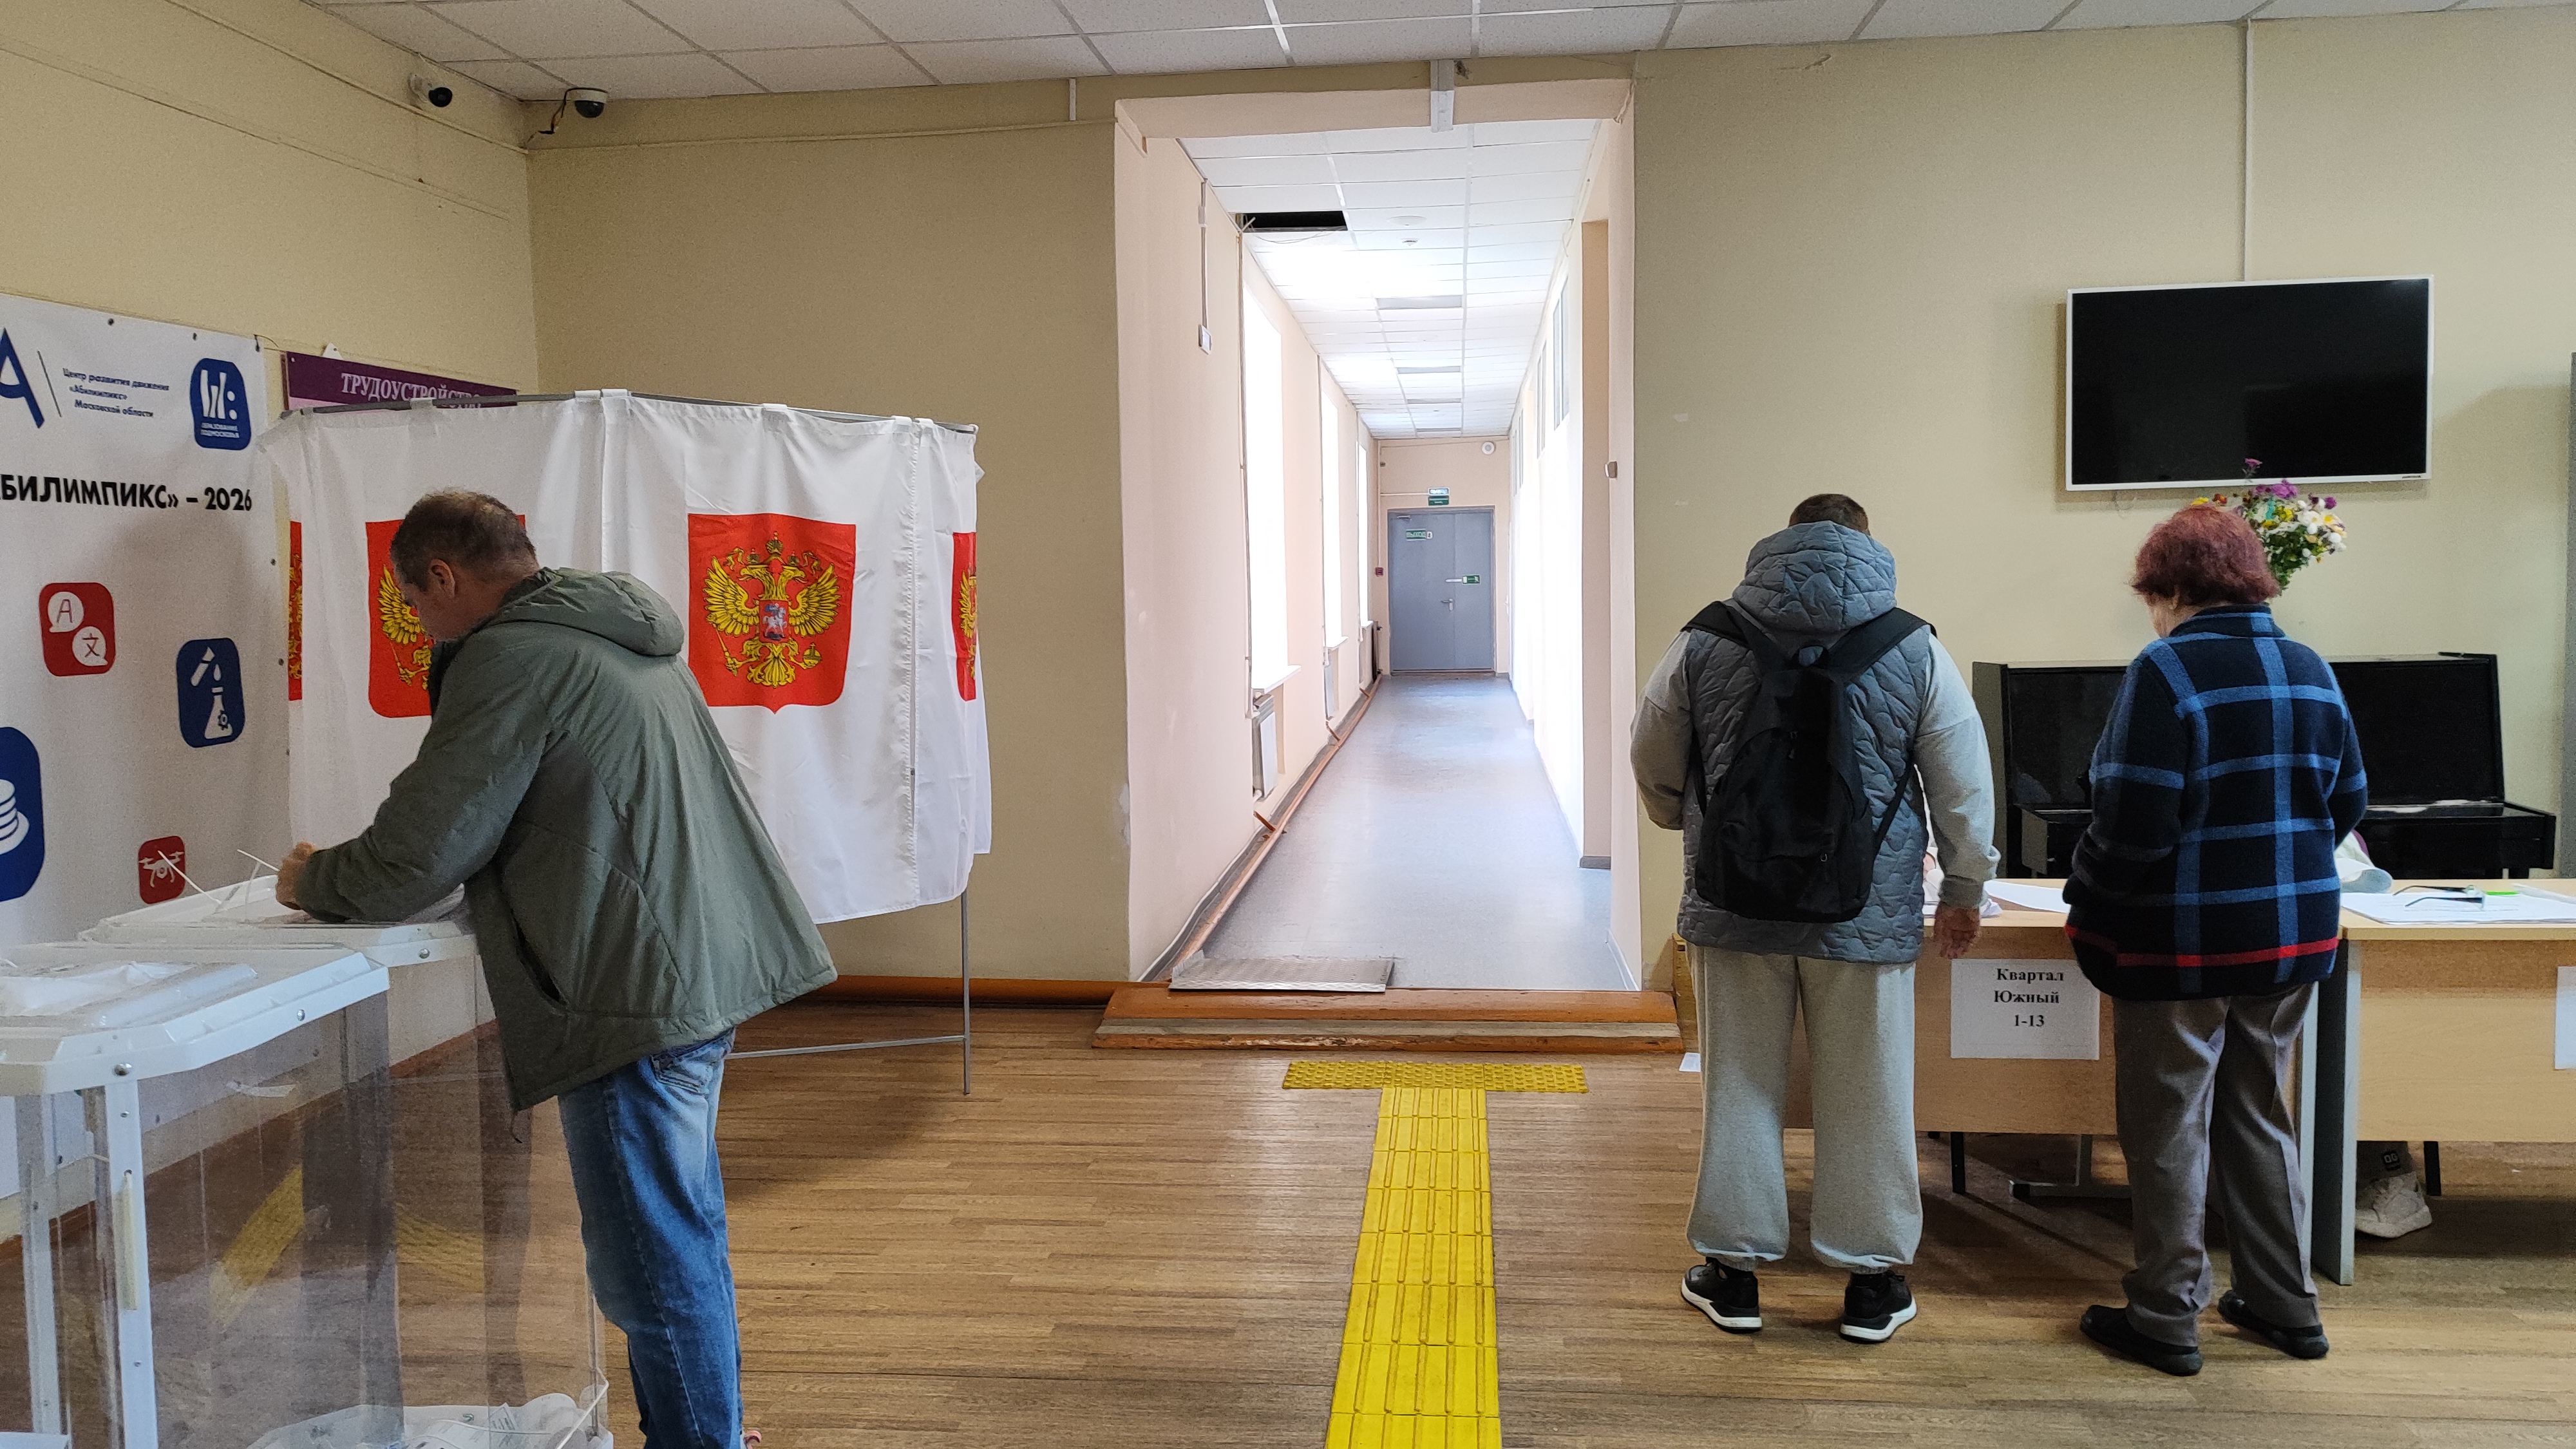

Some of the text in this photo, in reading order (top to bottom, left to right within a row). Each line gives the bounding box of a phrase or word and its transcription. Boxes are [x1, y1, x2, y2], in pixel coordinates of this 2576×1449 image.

[341, 372, 480, 402] ТРУДОУСТРОЙ
[0, 473, 179, 509] БИЛИМПИКС»
[204, 486, 252, 511] 2026
[1996, 968, 2064, 984] Квартал
[1994, 990, 2060, 1004] Южный
[2014, 1014, 2045, 1027] 1-13
